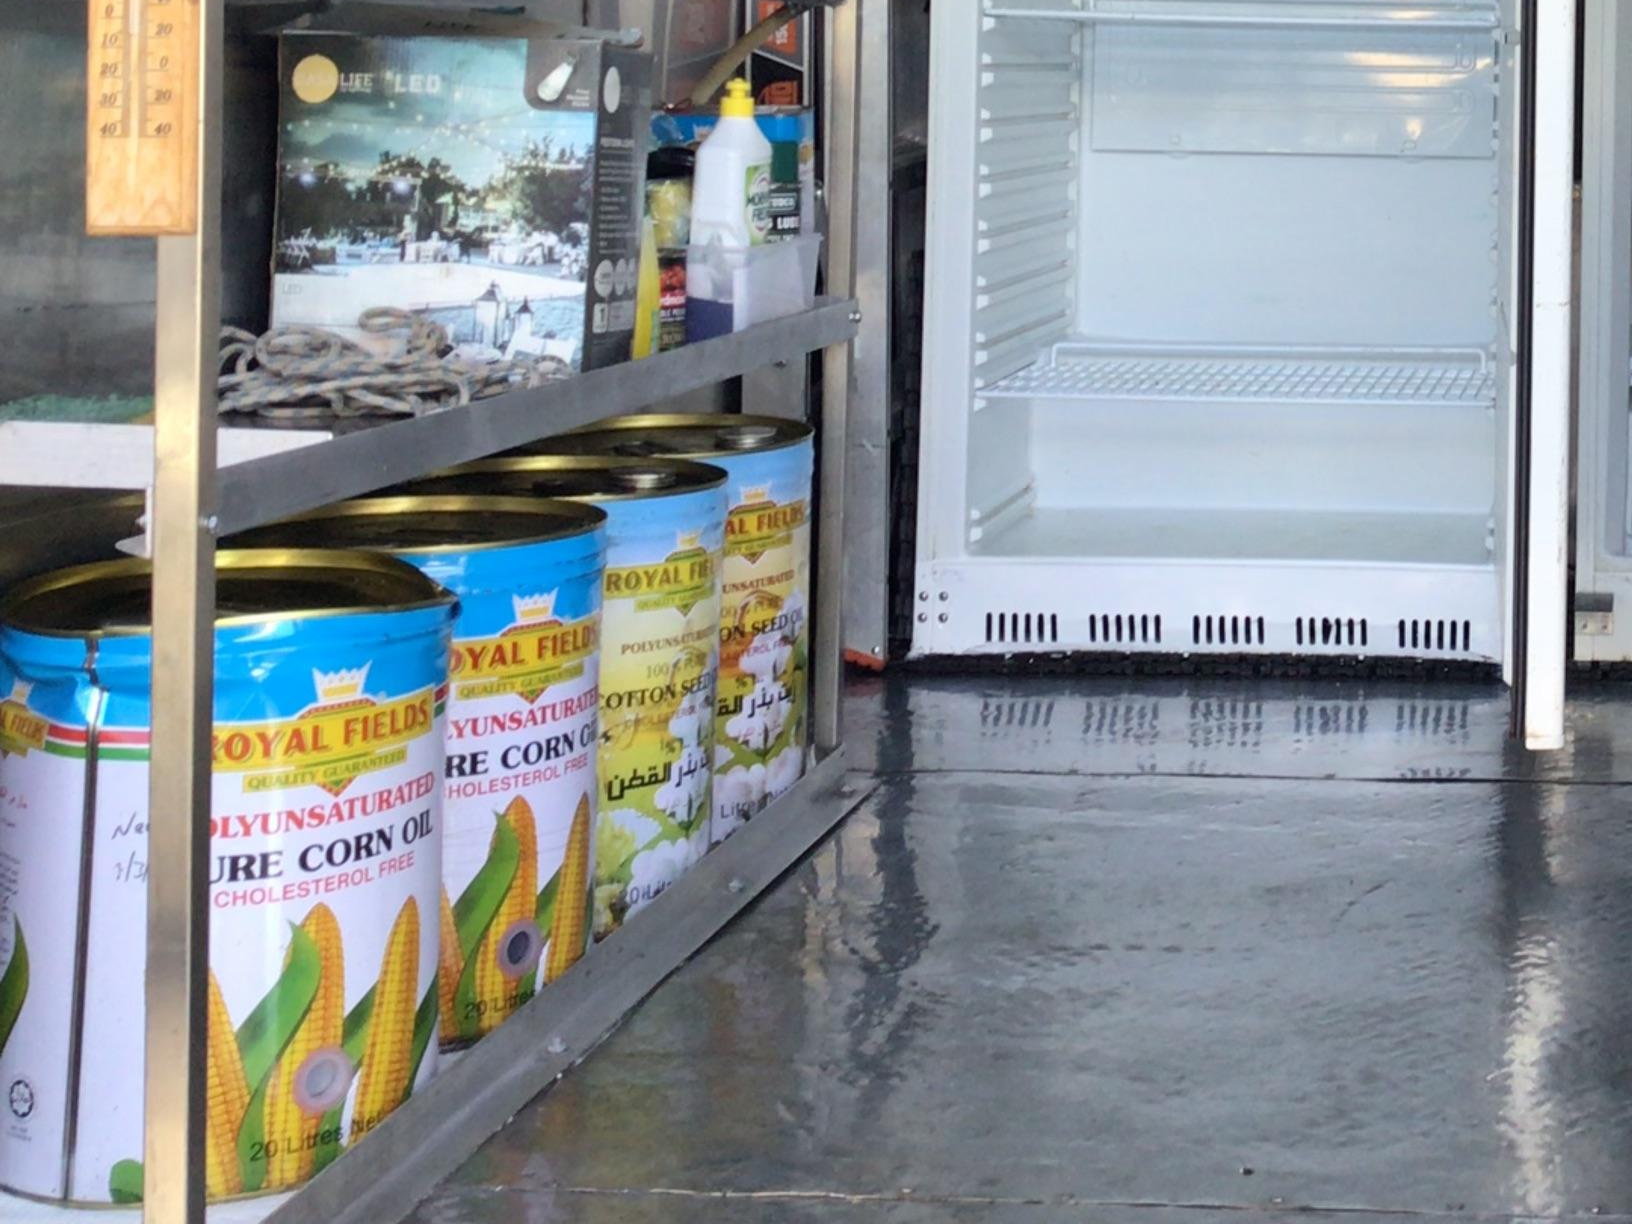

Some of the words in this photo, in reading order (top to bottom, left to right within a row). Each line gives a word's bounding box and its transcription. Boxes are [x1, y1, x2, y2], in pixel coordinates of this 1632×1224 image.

[102, 33, 118, 47] 10
[100, 123, 116, 135] 40
[154, 123, 172, 134] 40
[605, 565, 683, 593] ROYAL
[722, 568, 795, 594] UNSATURATED
[450, 641, 525, 672] OYAL
[343, 697, 429, 746] FIELDS
[446, 751, 488, 778] RE
[501, 731, 575, 770] CORN
[448, 763, 560, 800] HOLESTEROL
[210, 851, 283, 884] URE
[299, 825, 393, 873] CORN
[402, 808, 432, 845] OIL
[214, 866, 374, 908] CHOLESTEROL
[378, 851, 416, 877] FREE
[249, 1139, 279, 1162] 20
[287, 1125, 343, 1154] Litres
